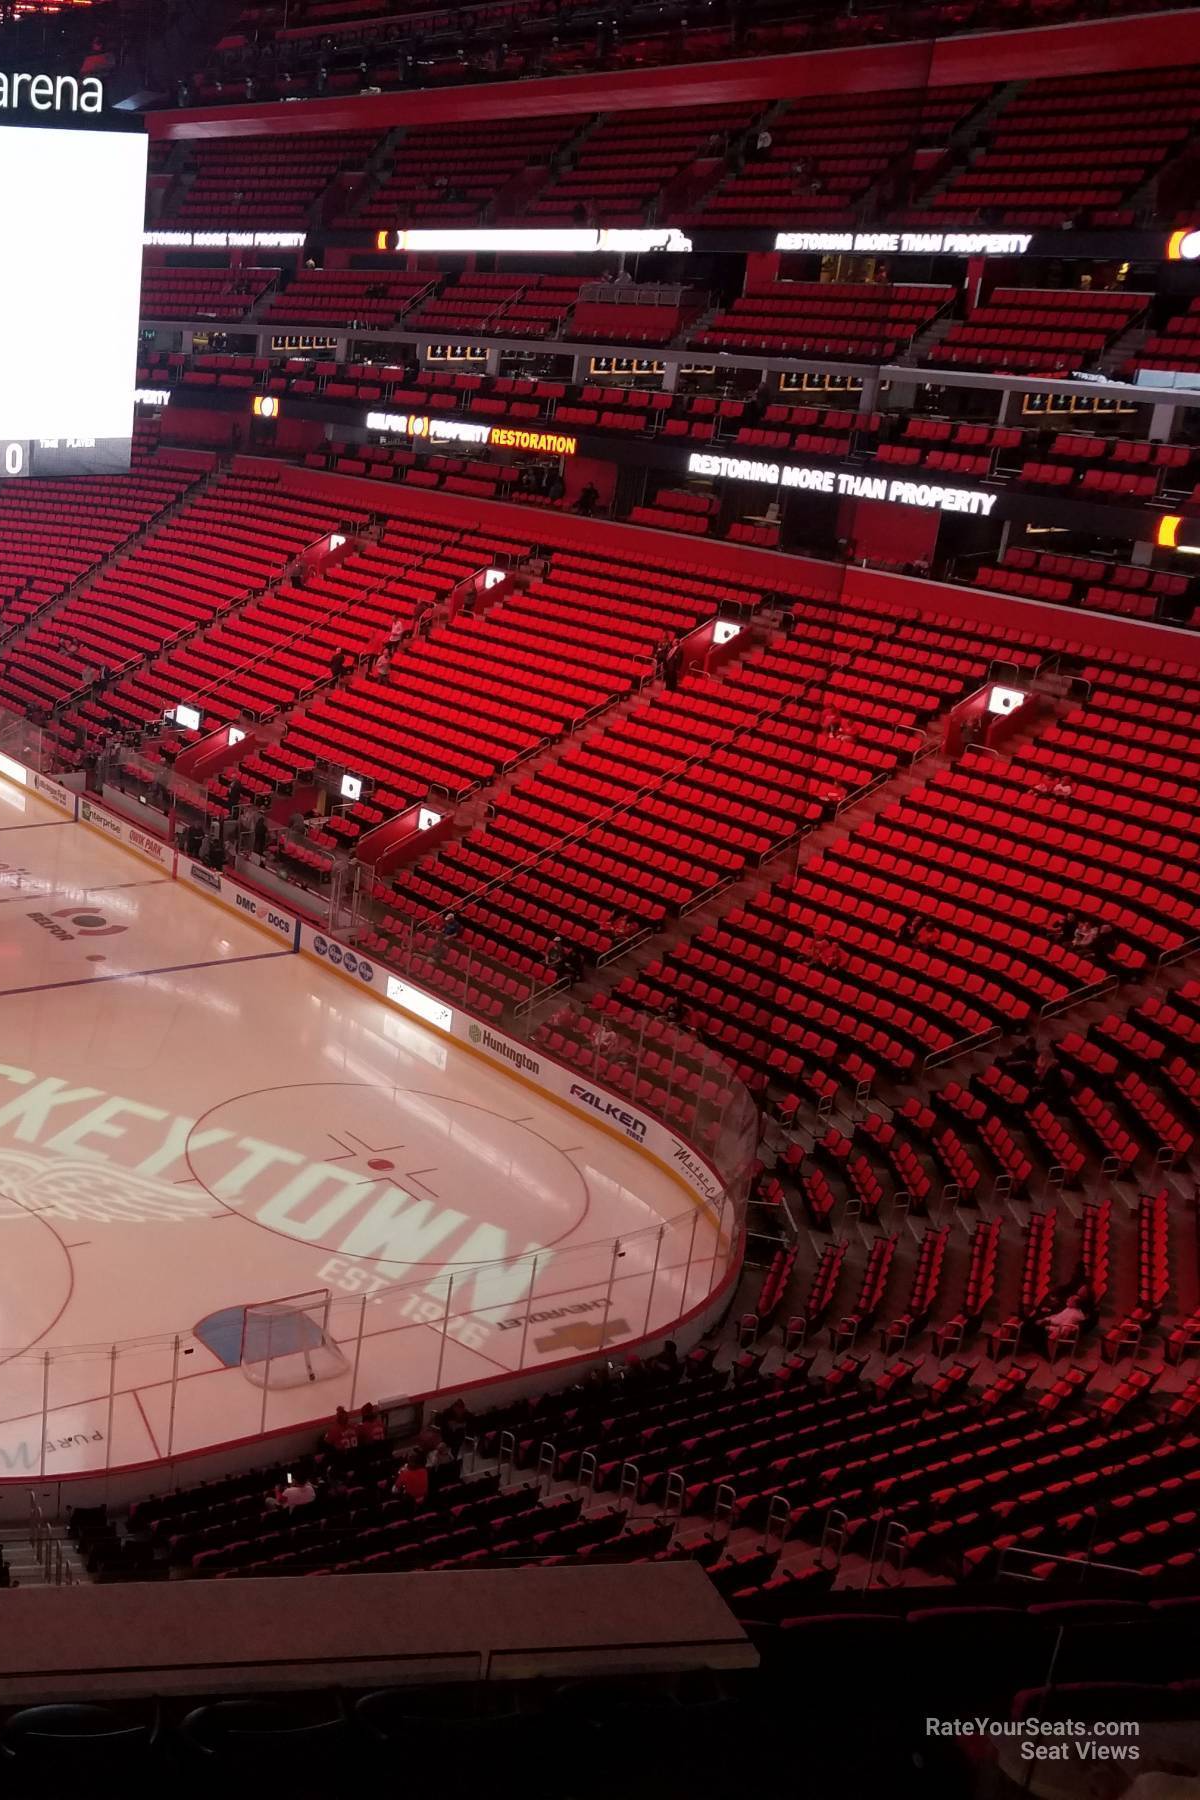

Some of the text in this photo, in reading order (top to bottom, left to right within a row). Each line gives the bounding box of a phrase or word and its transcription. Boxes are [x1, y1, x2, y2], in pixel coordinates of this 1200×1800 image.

[775, 233, 1032, 253] RESTORING MORE THAN PROPERTY
[67, 438, 95, 448] PLAYER
[491, 428, 577, 454] RESTORATION
[5, 443, 23, 474] 0
[689, 453, 997, 516] RESTORING MORE THAN PROPERTY
[145, 839, 162, 857] PARK
[26, 912, 75, 941] BELFOR
[236, 894, 290, 933] DMC DOCS
[483, 1030, 539, 1075] Huntington
[570, 1084, 647, 1136] FALKEN
[625, 1128, 644, 1143] TIRES
[672, 1139, 710, 1184] Motor
[317, 1257, 391, 1304] EST.
[496, 1297, 613, 1331] CHEVROLET
[47, 1430, 104, 1453] PURE
